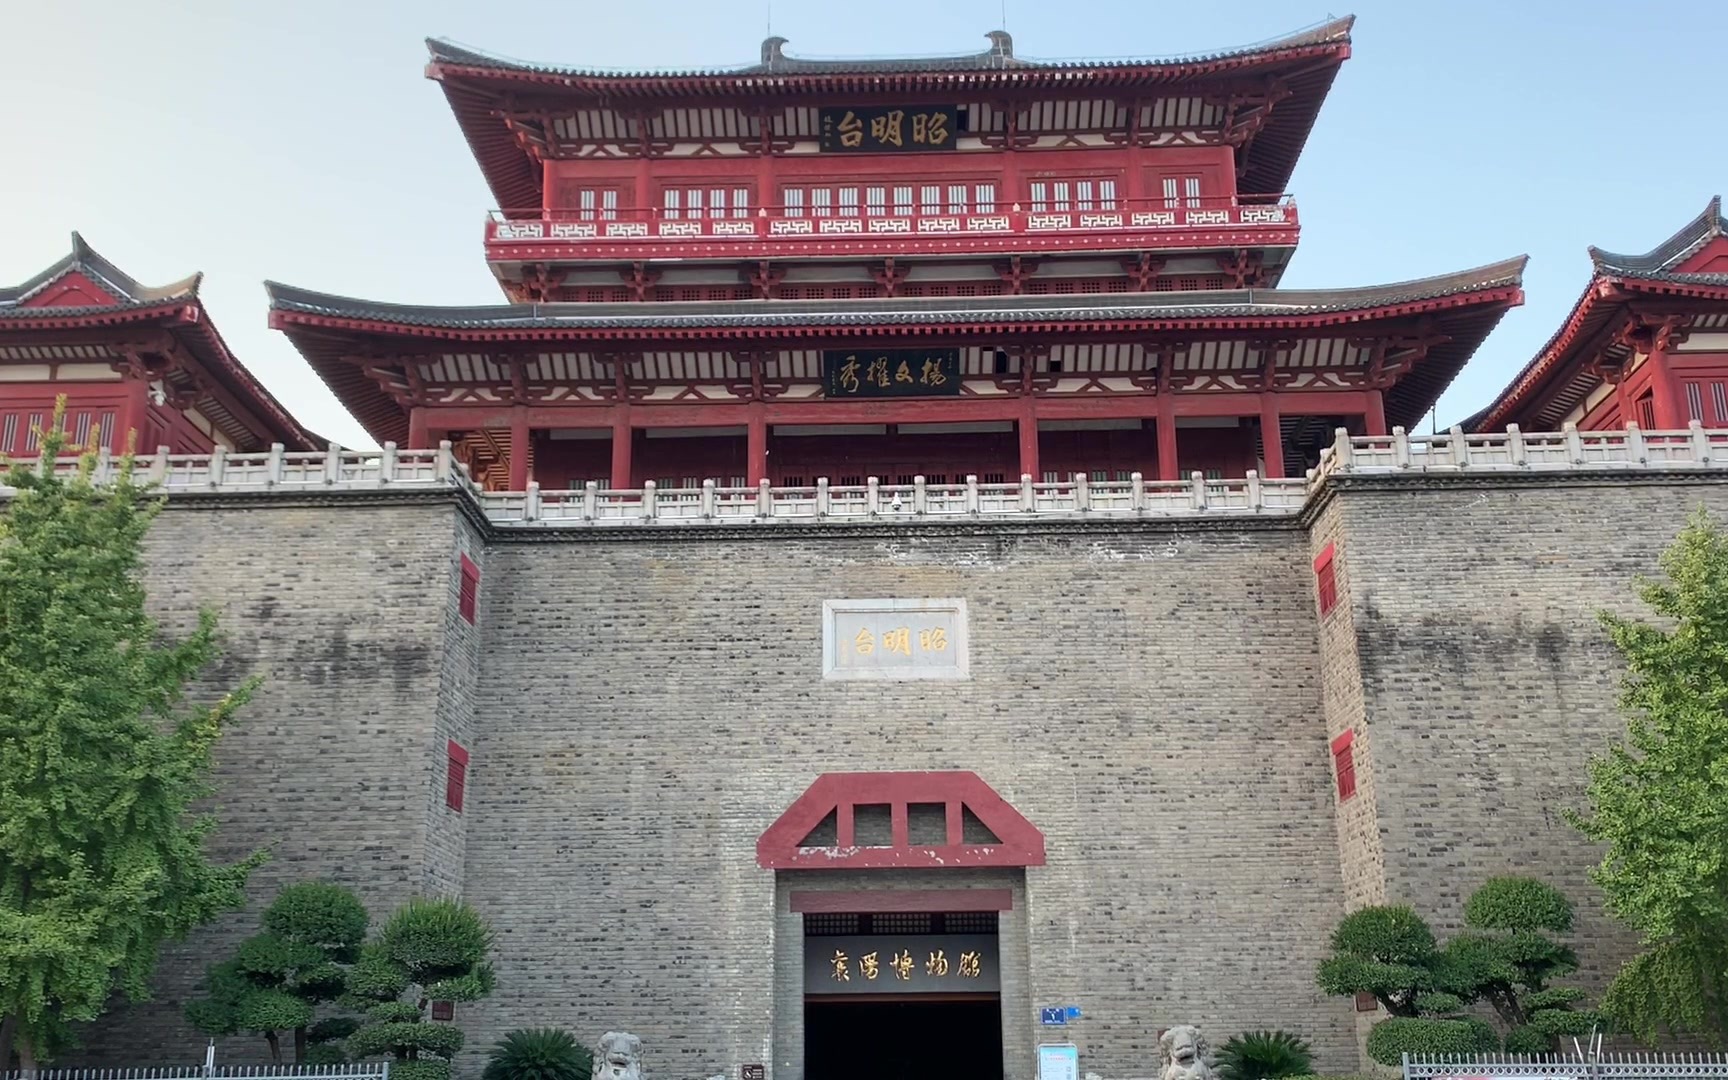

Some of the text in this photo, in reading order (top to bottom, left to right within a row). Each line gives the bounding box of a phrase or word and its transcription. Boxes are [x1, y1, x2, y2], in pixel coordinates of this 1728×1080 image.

[837, 110, 949, 147] 昭明台
[855, 626, 948, 656] 昭明台
